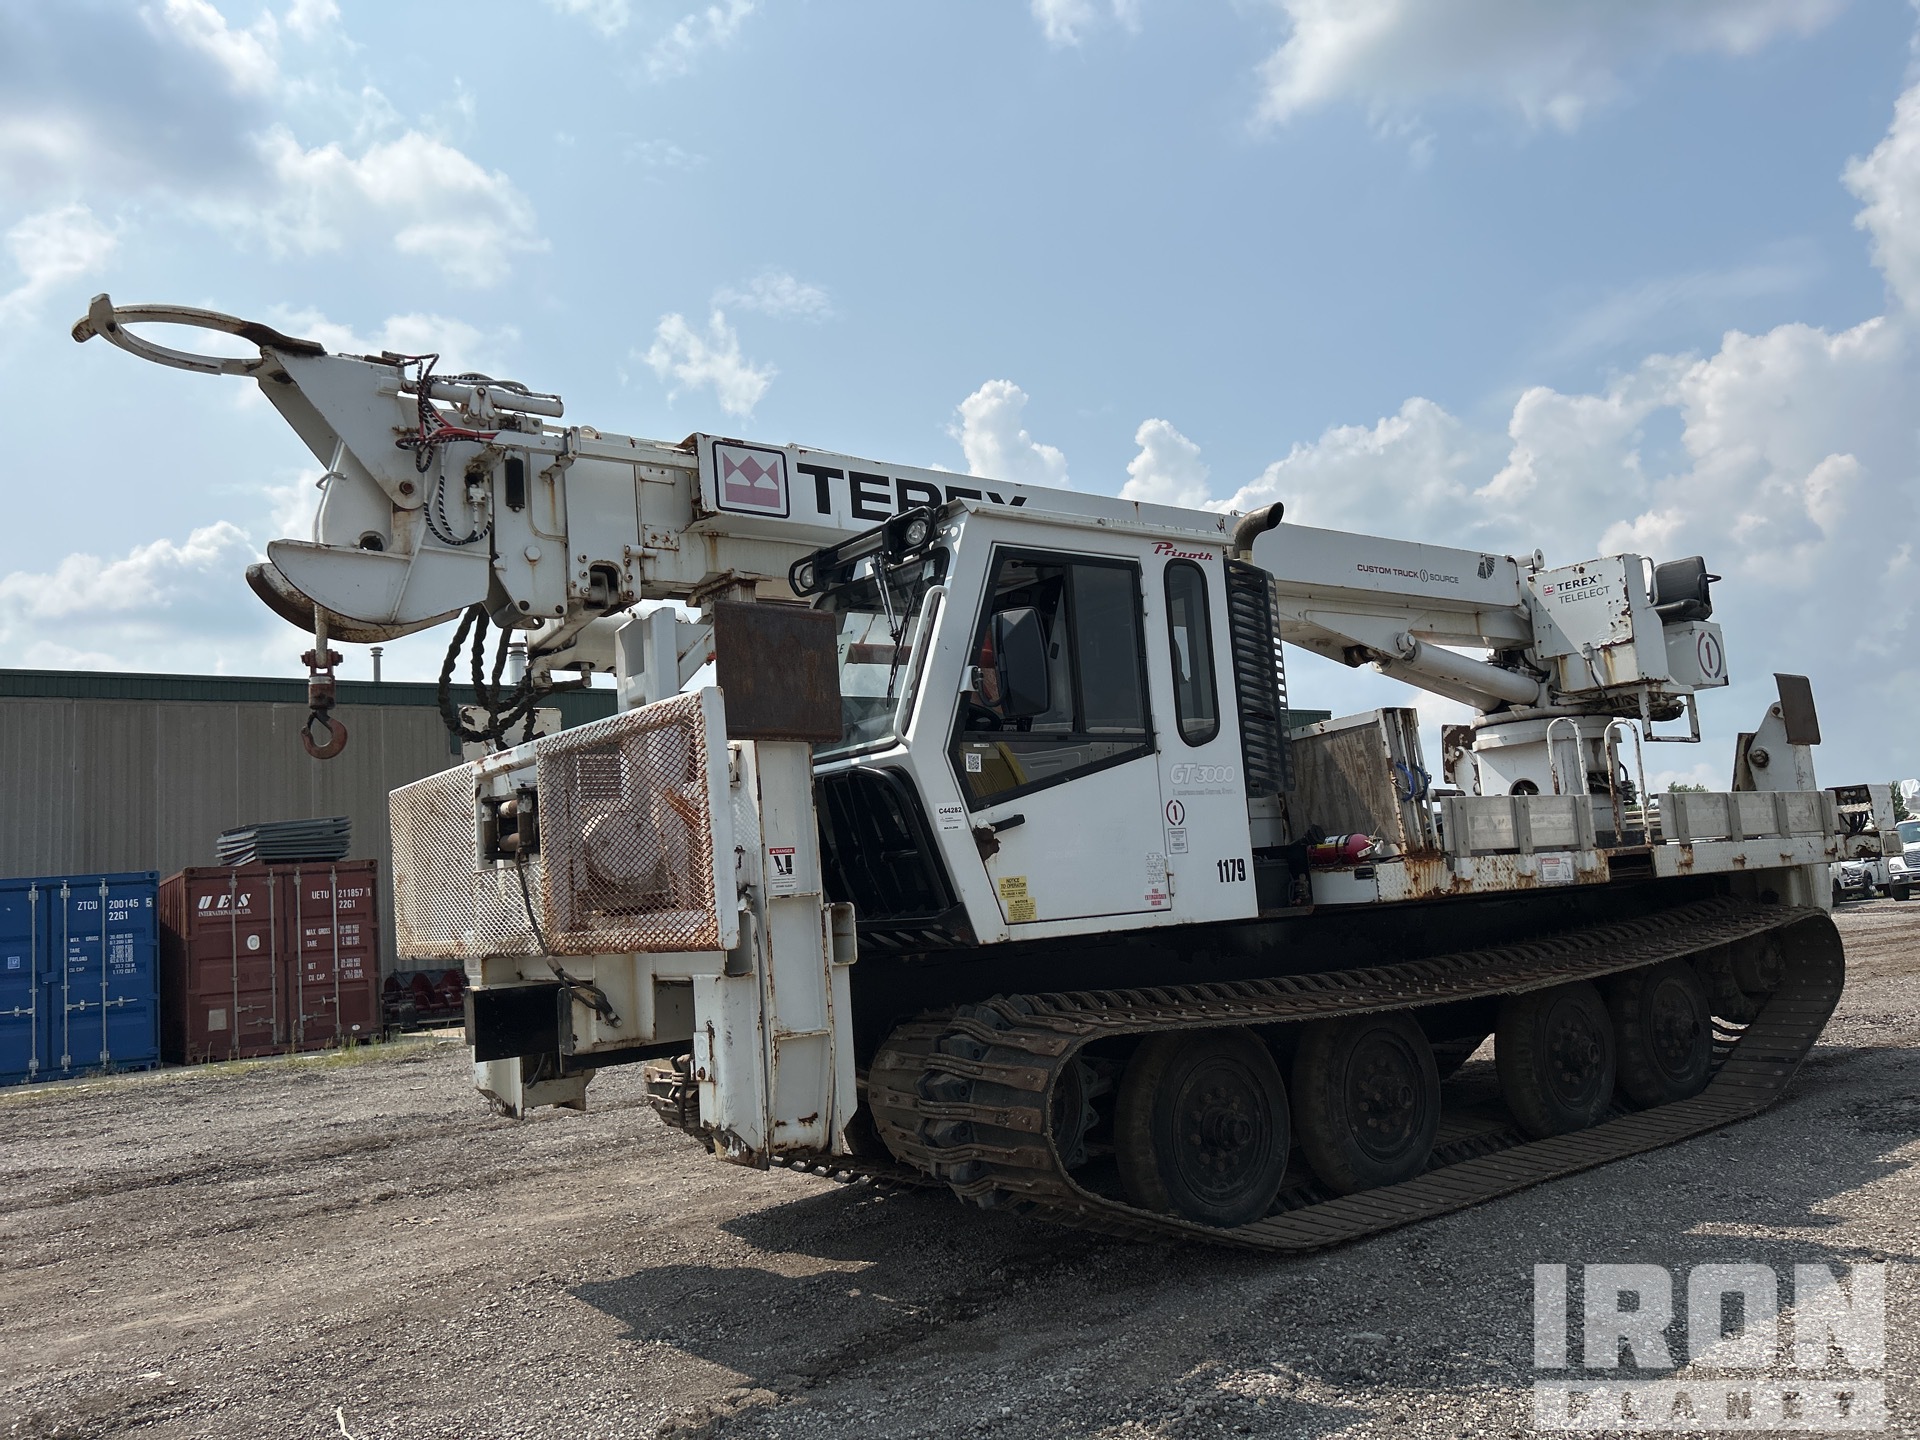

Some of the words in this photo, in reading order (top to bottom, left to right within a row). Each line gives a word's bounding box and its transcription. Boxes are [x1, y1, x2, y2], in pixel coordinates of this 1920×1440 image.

[1151, 541, 1213, 561] Prinoth
[1357, 563, 1392, 575] CUSTOM
[1393, 568, 1419, 579] TRUCK
[1430, 573, 1460, 584] SOURCE
[1557, 574, 1598, 592] TEREX
[1559, 585, 1610, 604] TELELECT
[1170, 763, 1197, 785] GT
[1195, 765, 1235, 784] 3000
[938, 806, 962, 815] C44282
[1216, 858, 1247, 883] 1179
[311, 890, 330, 899] UETU
[338, 888, 364, 898] 211857
[77, 901, 98, 911] ZTCU
[108, 899, 139, 910] 200145
[146, 898, 153, 908] 5
[338, 899, 356, 909] 22G1
[108, 910, 129, 921] 22G1
